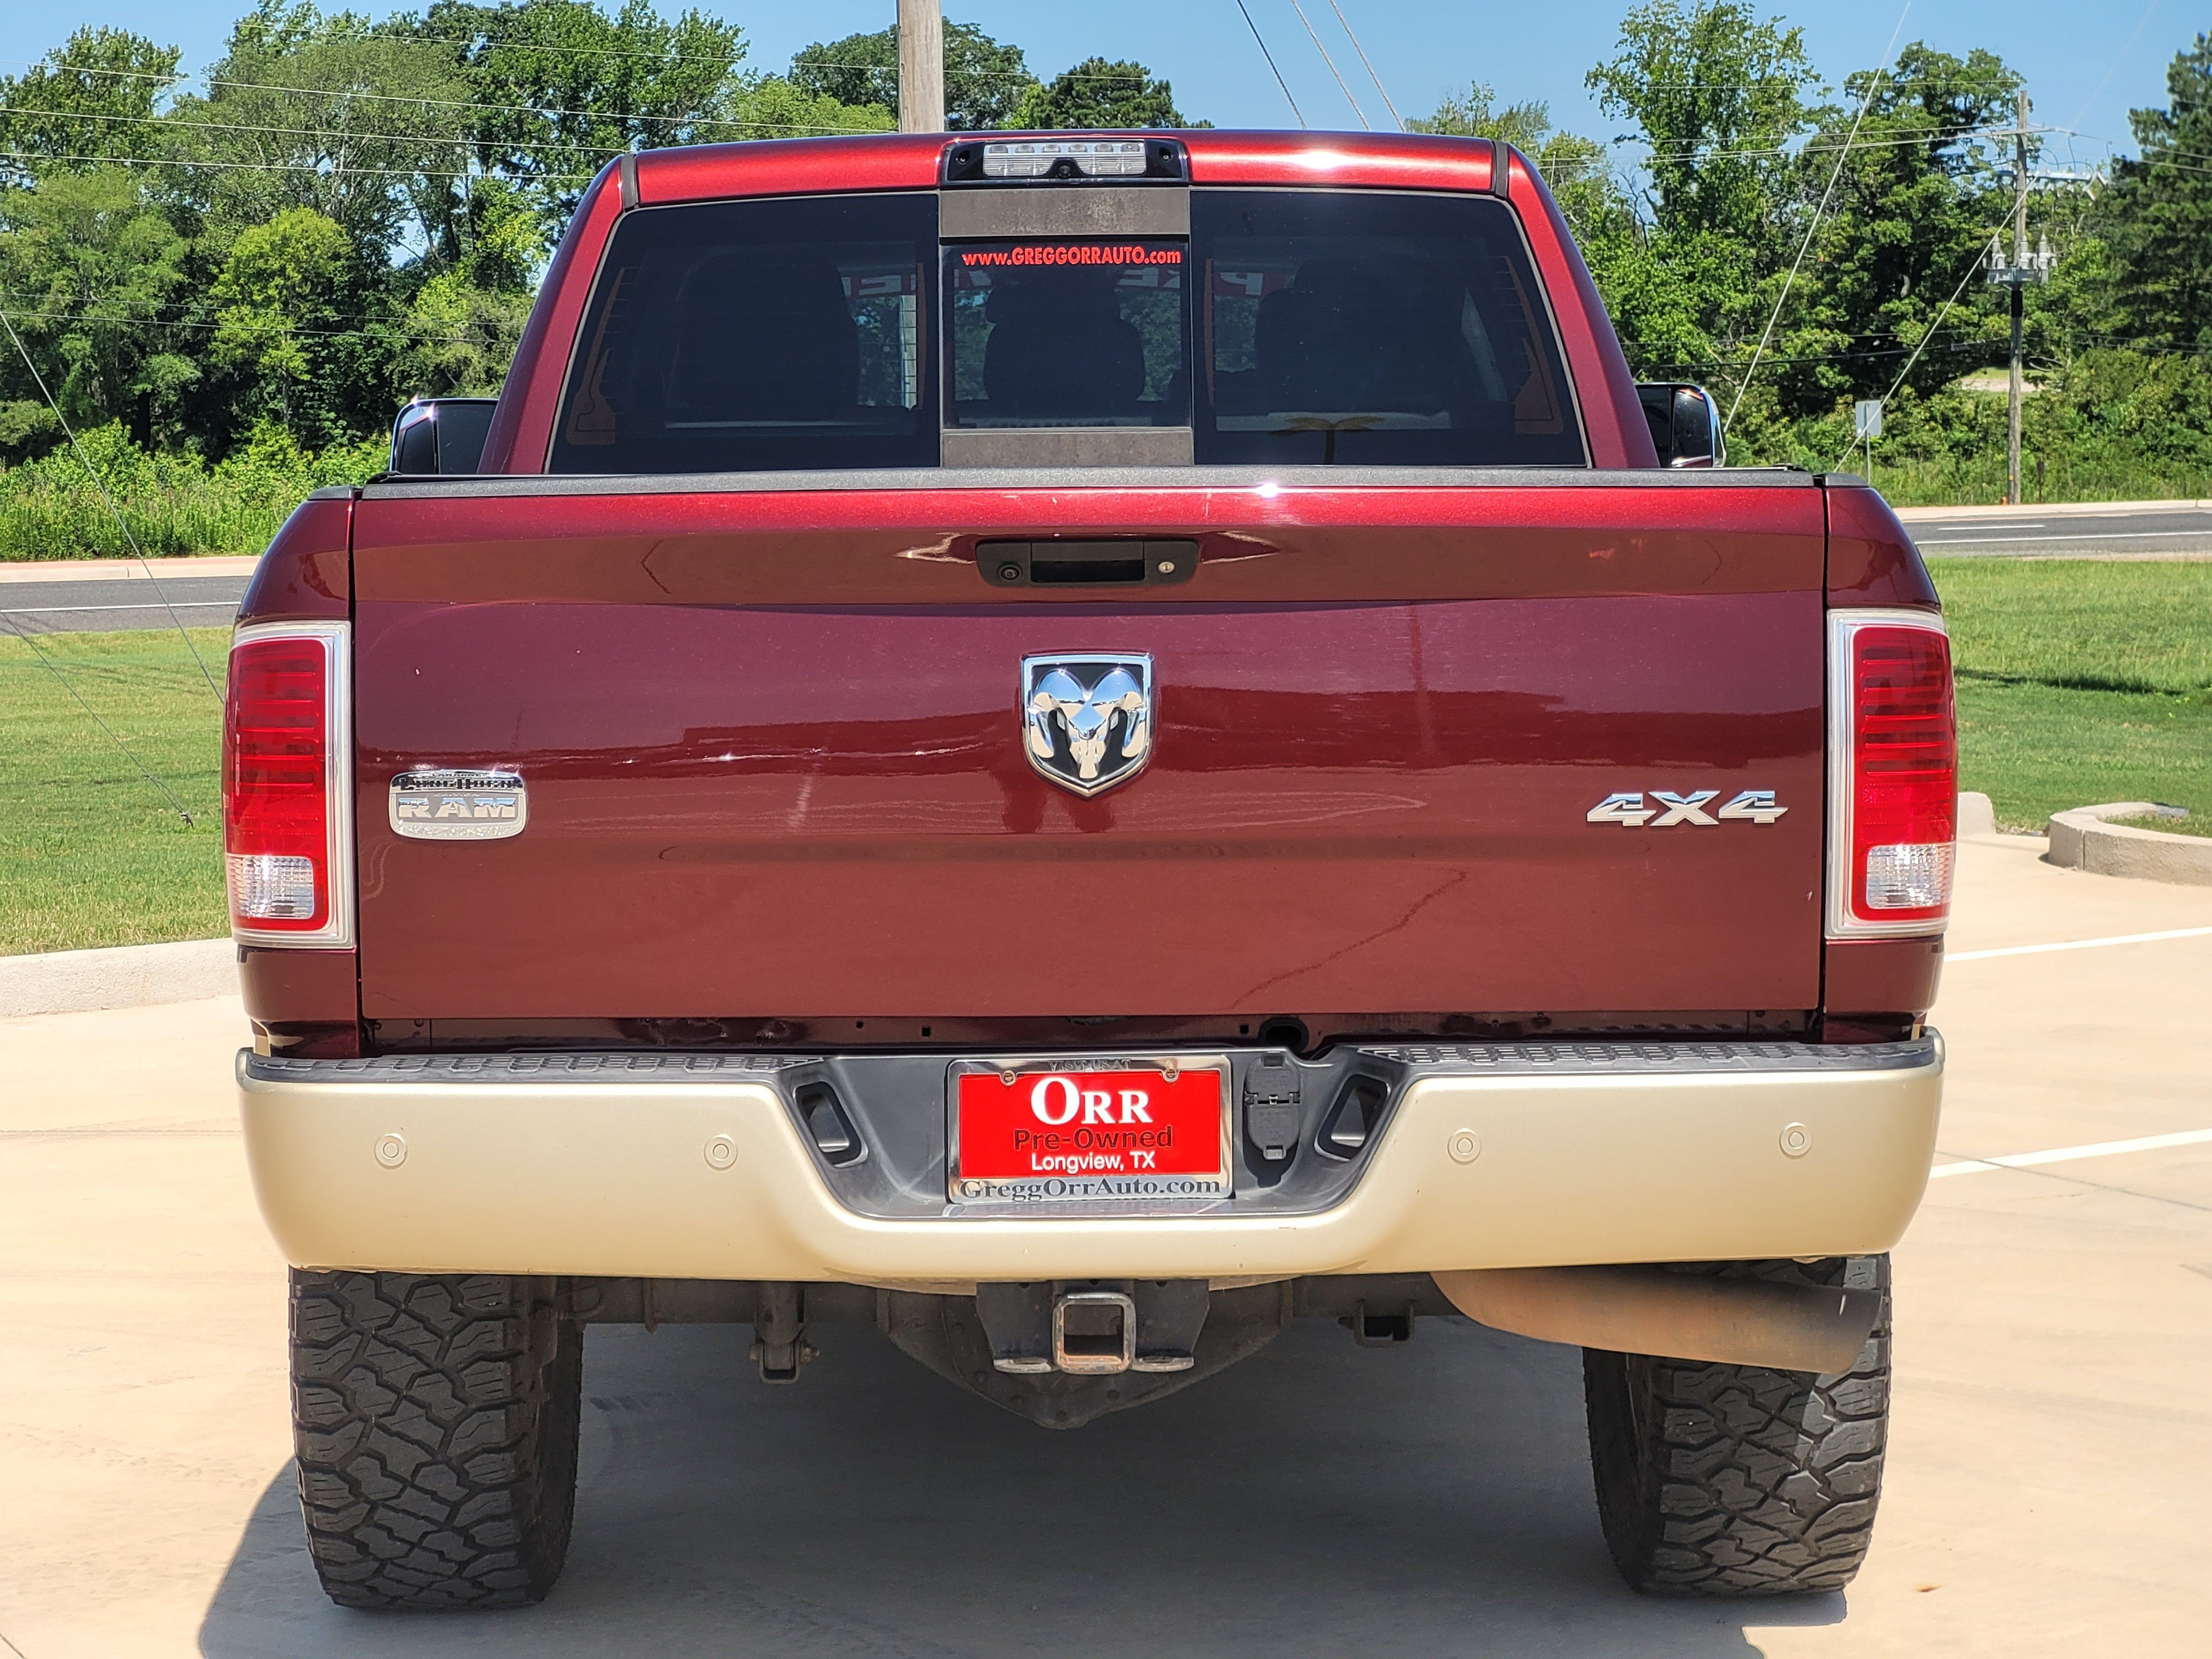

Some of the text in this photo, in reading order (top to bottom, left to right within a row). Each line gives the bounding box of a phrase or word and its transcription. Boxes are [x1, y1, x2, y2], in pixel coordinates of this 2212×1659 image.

[961, 246, 1182, 266] www.GREGGORRAUTO.com
[398, 797, 517, 819] RAM
[1586, 790, 1789, 827] 4X4
[1014, 1126, 1173, 1150] Pre-Owned
[1031, 1151, 1155, 1173] Longview, TX
[960, 1178, 1221, 1201] GreggOrrAuto.com
